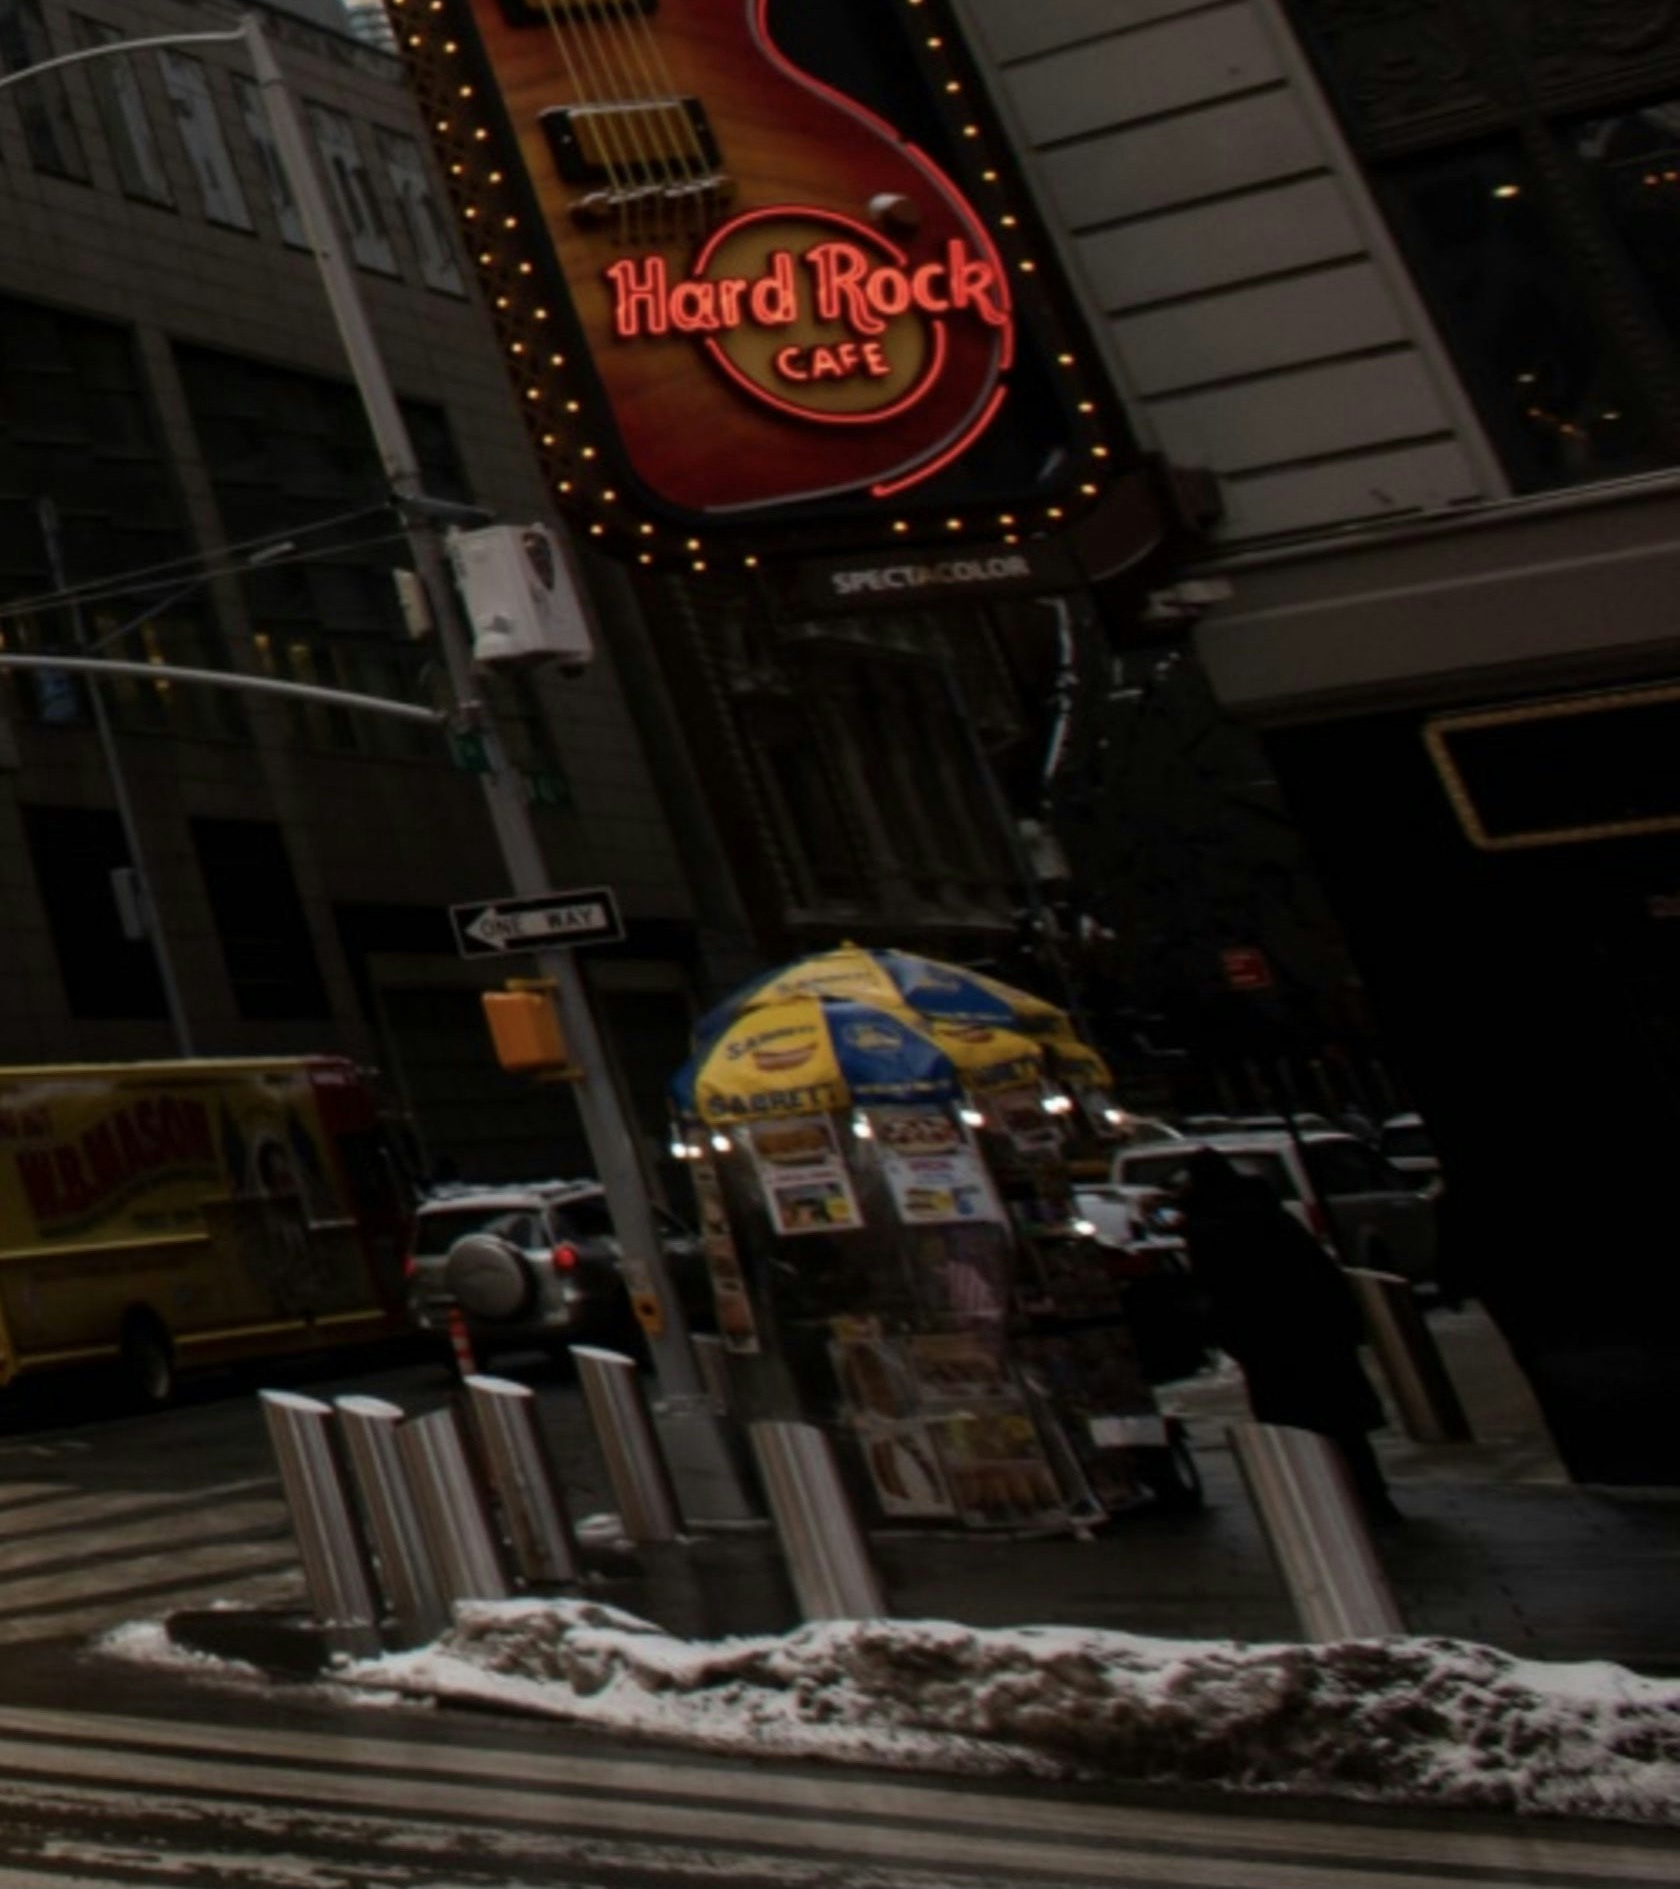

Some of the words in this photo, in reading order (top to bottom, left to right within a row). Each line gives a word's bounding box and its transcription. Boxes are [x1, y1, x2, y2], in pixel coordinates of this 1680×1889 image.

[607, 251, 799, 337] Hard
[805, 238, 1010, 336] Rock
[776, 342, 891, 383] CAFE
[830, 554, 1031, 595] SPECTACOLOR
[479, 918, 522, 937] ONE
[547, 907, 594, 930] WAY
[708, 1081, 840, 1118] SABRETT
